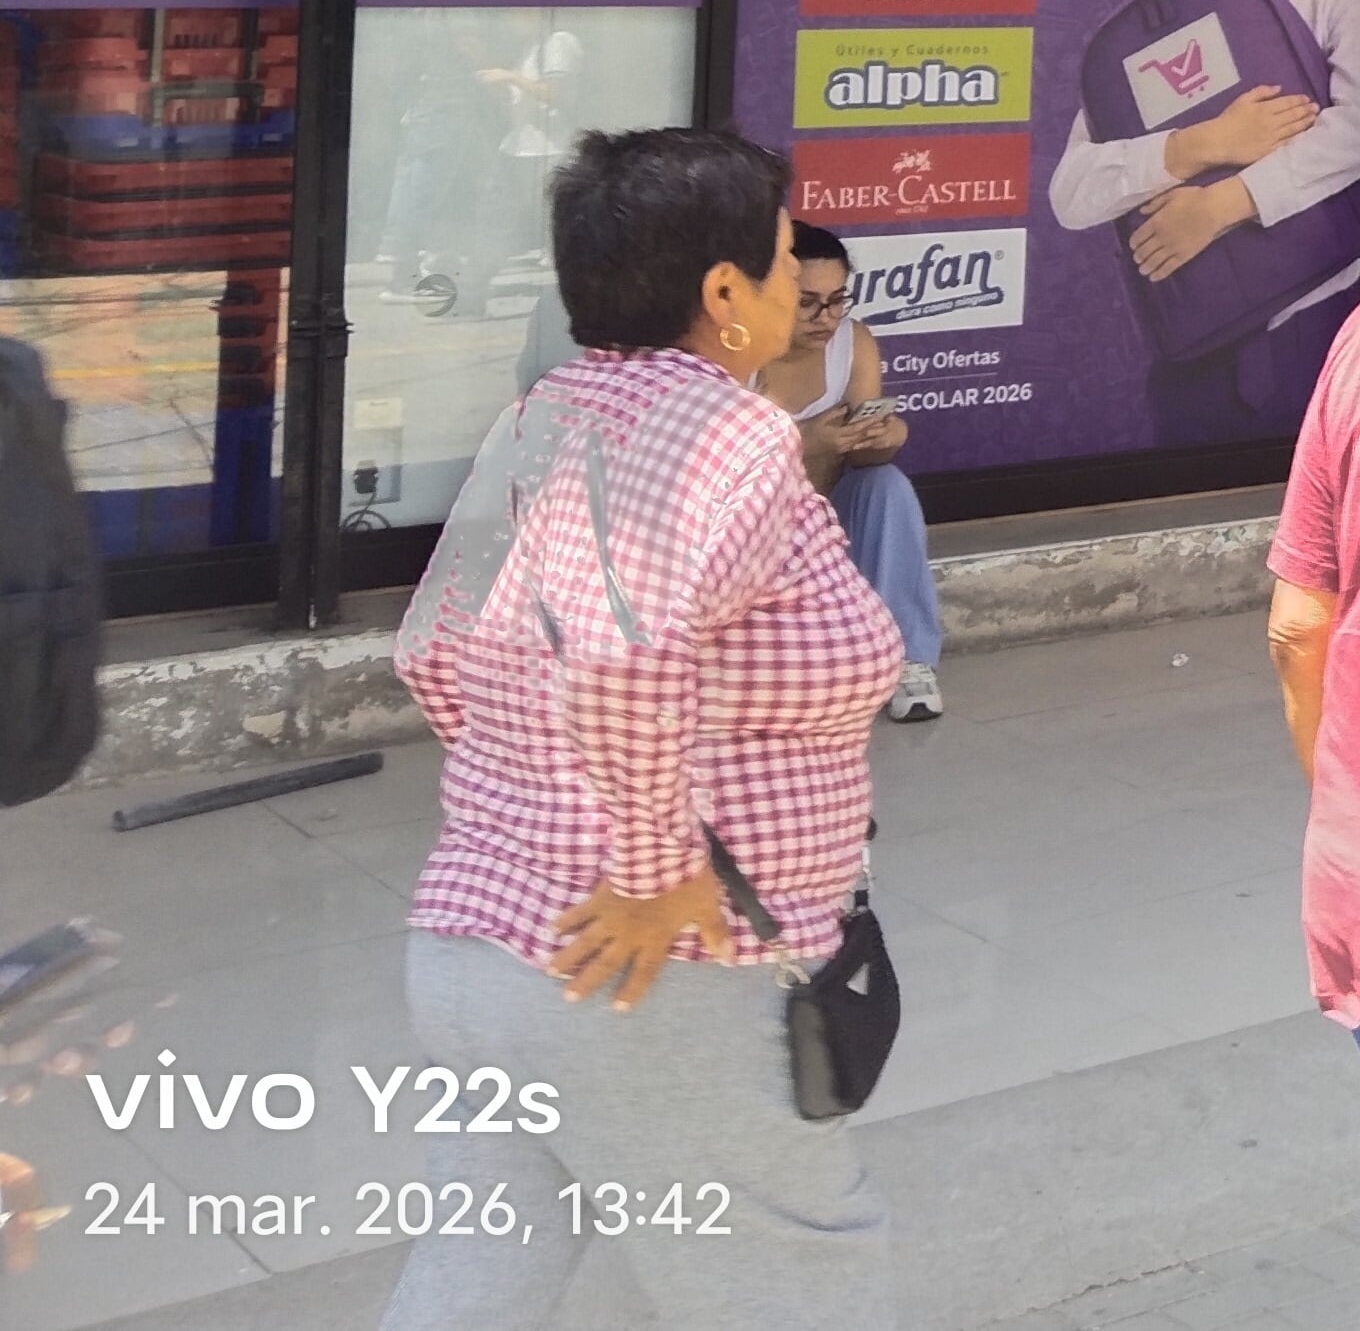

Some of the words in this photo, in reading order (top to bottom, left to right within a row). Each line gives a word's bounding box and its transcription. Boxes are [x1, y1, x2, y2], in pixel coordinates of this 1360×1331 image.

[890, 47, 900, 57] y
[906, 44, 989, 56] Cuadernos
[826, 61, 998, 108] alpha
[801, 175, 1017, 211] FABER-CASTELL
[892, 354, 931, 375] City
[932, 350, 1000, 370] Ofertas
[983, 382, 1032, 405] 2026
